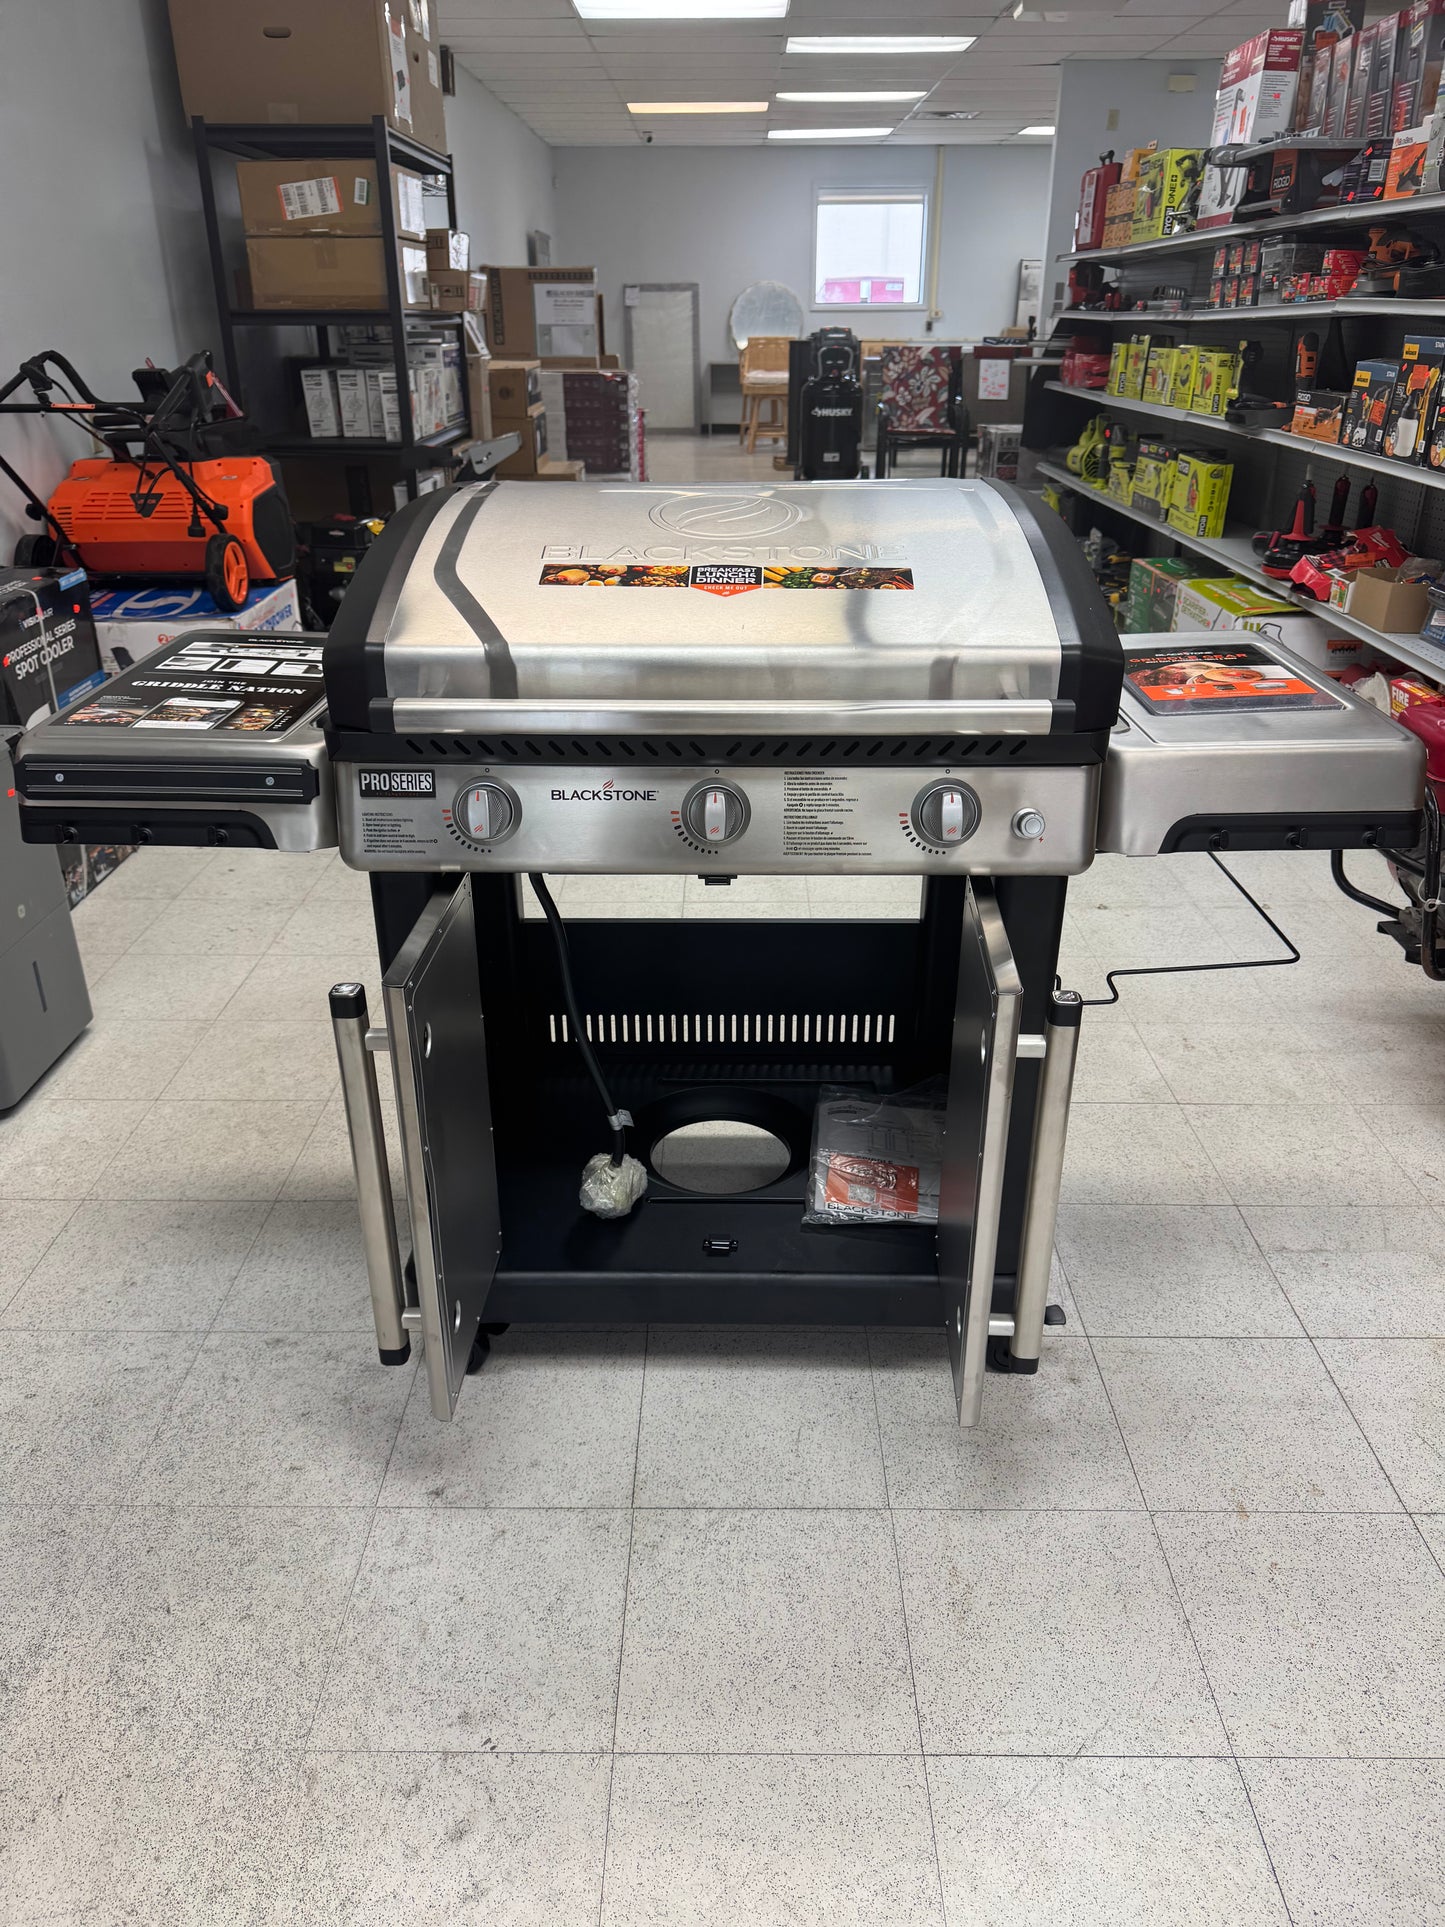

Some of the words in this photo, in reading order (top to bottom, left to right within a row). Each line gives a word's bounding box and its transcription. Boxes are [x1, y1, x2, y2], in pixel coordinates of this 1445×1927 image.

[820, 407, 853, 417] HUSKY
[1198, 516, 1207, 536] RYOBI
[540, 544, 908, 562] BLACKSTONE
[53, 618, 77, 639] SERIES
[15, 654, 39, 680] SPOT
[40, 635, 75, 665] COOLER
[131, 680, 223, 690] GRIDDLE
[227, 685, 307, 695] NATION
[1391, 685, 1410, 707] FIRE
[360, 773, 390, 791] PRO
[391, 773, 432, 791] SERIES
[550, 789, 657, 801] BLACKSTONE
[827, 1202, 915, 1220] BLACKSTONE
